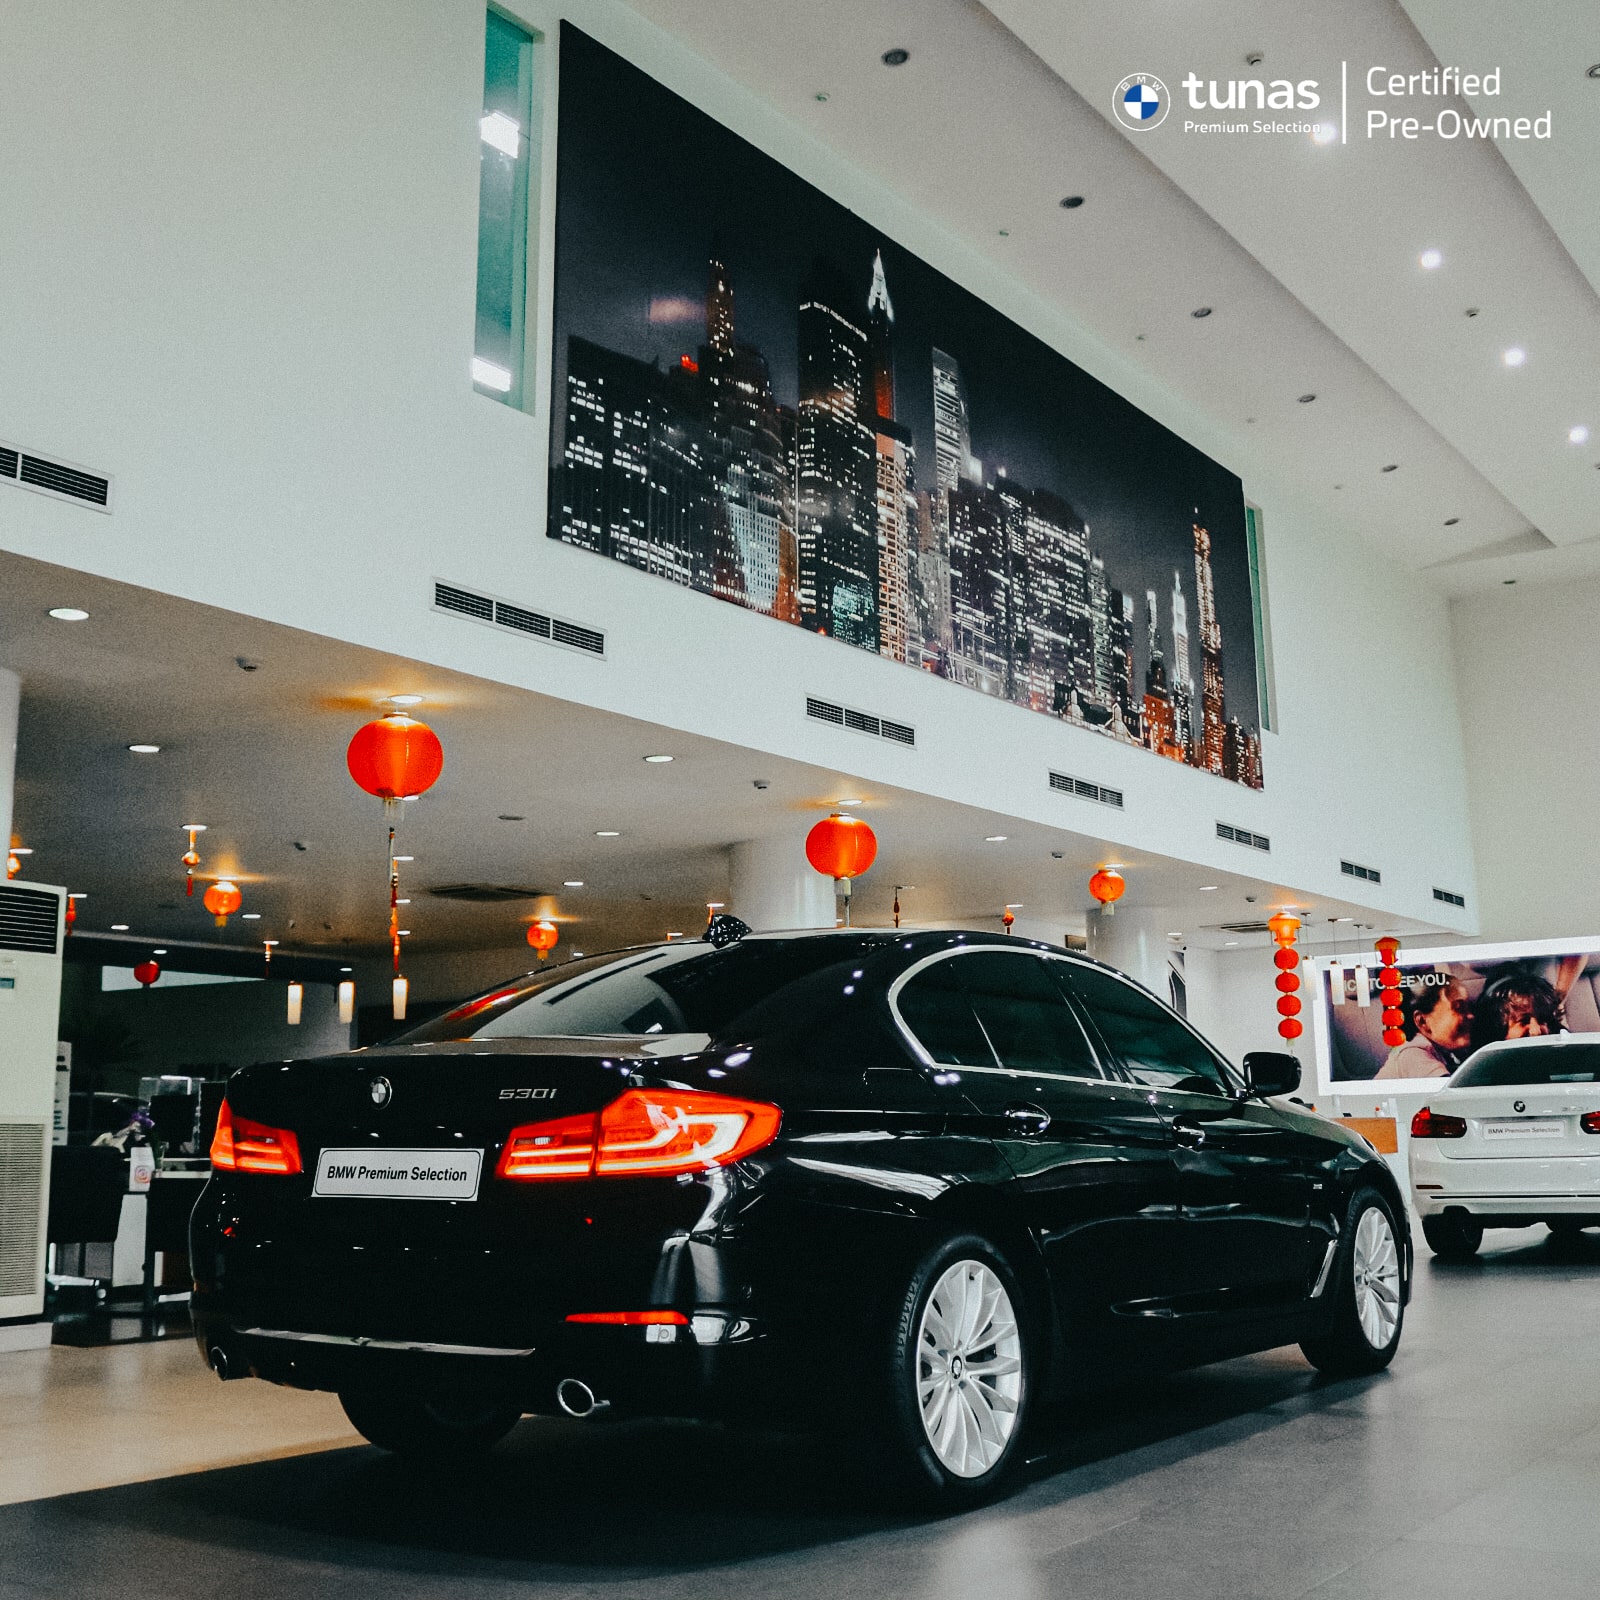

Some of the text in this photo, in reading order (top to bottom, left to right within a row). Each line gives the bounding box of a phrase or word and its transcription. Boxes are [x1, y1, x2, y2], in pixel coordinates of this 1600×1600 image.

[1415, 973, 1450, 987] YOU.
[1487, 1127, 1504, 1135] BMW
[326, 1165, 468, 1181] BMW Premium Selection
